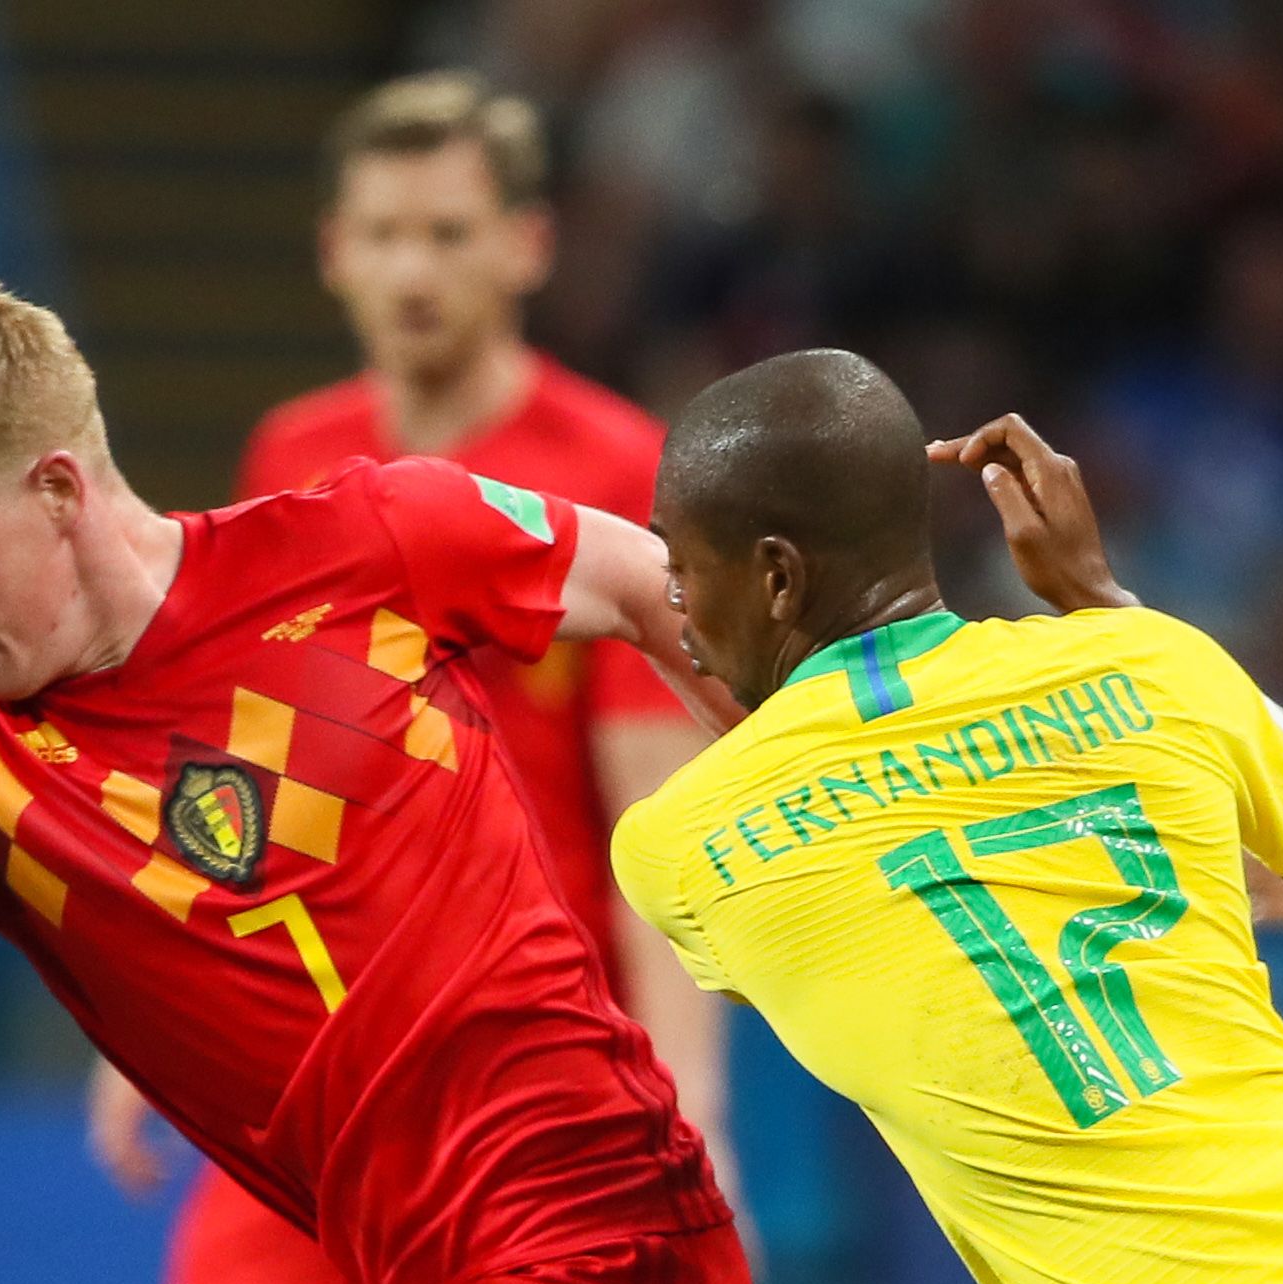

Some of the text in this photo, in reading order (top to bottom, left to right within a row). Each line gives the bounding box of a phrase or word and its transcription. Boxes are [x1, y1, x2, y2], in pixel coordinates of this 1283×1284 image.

[702, 671, 1155, 887] FERNANDINHO
[227, 893, 348, 1014] 7
[877, 781, 1190, 1130] 17
